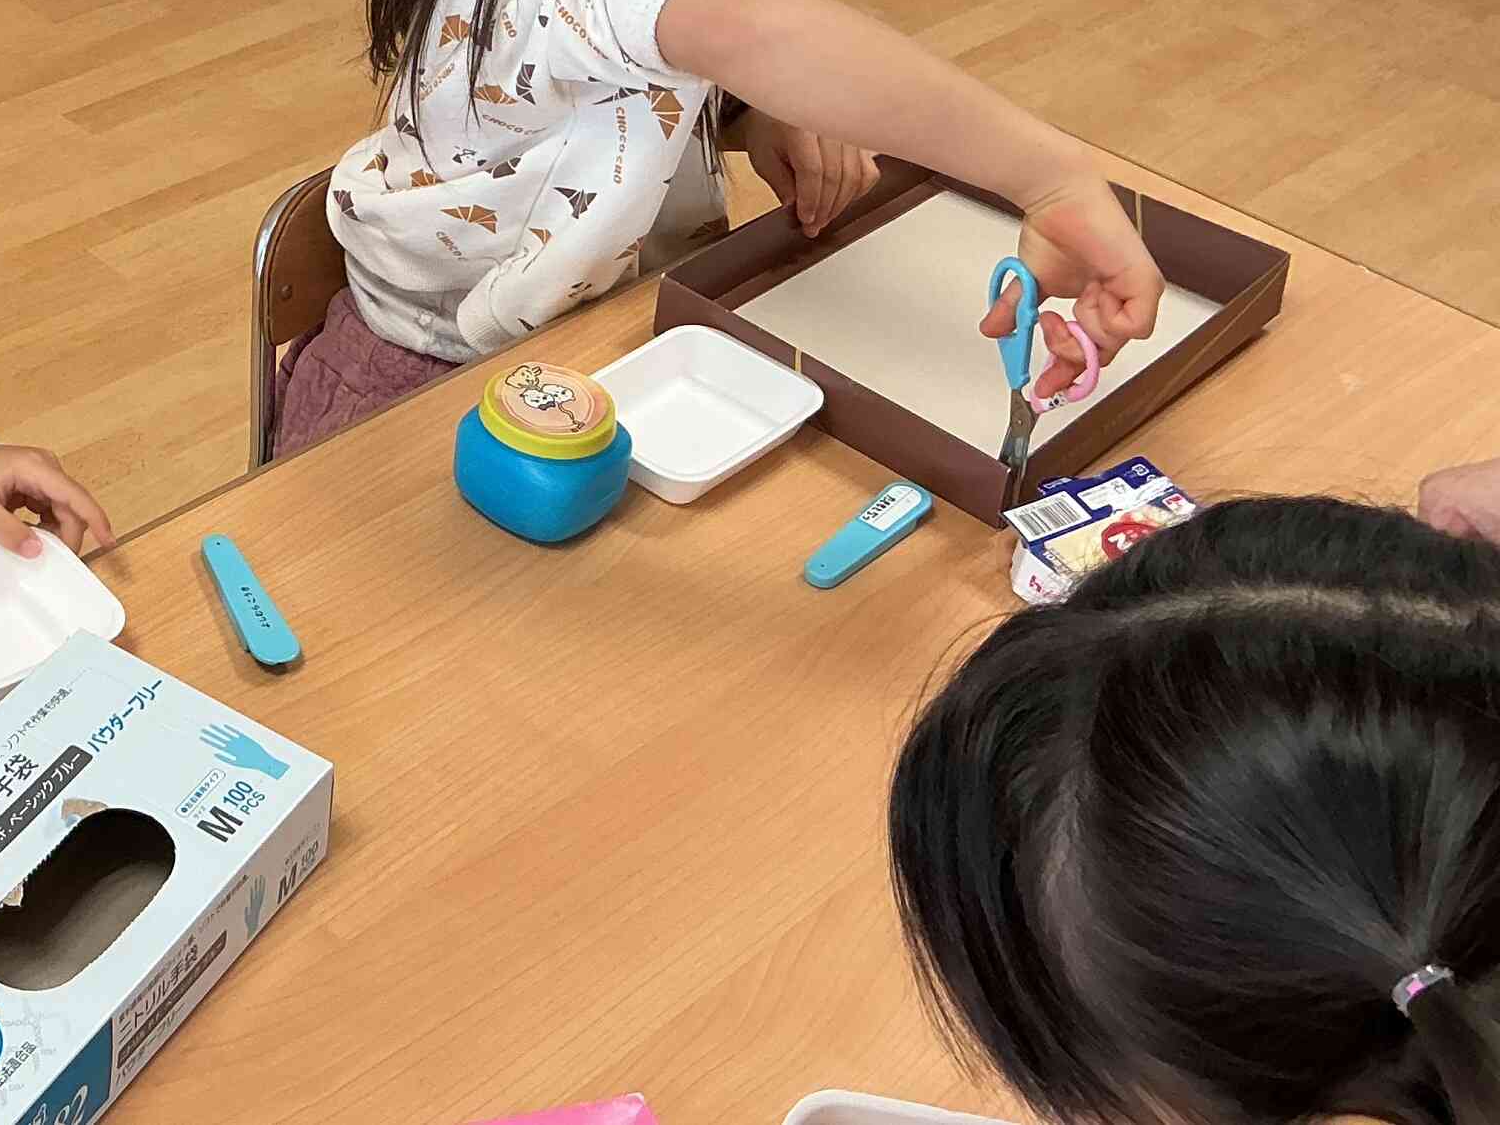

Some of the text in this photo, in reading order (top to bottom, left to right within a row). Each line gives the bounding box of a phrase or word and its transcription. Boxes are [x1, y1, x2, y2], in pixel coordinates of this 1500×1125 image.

[87, 679, 162, 753] パウダーフリー
[197, 780, 254, 843] M 100
[239, 791, 266, 815] PCS
[276, 862, 299, 905] M
